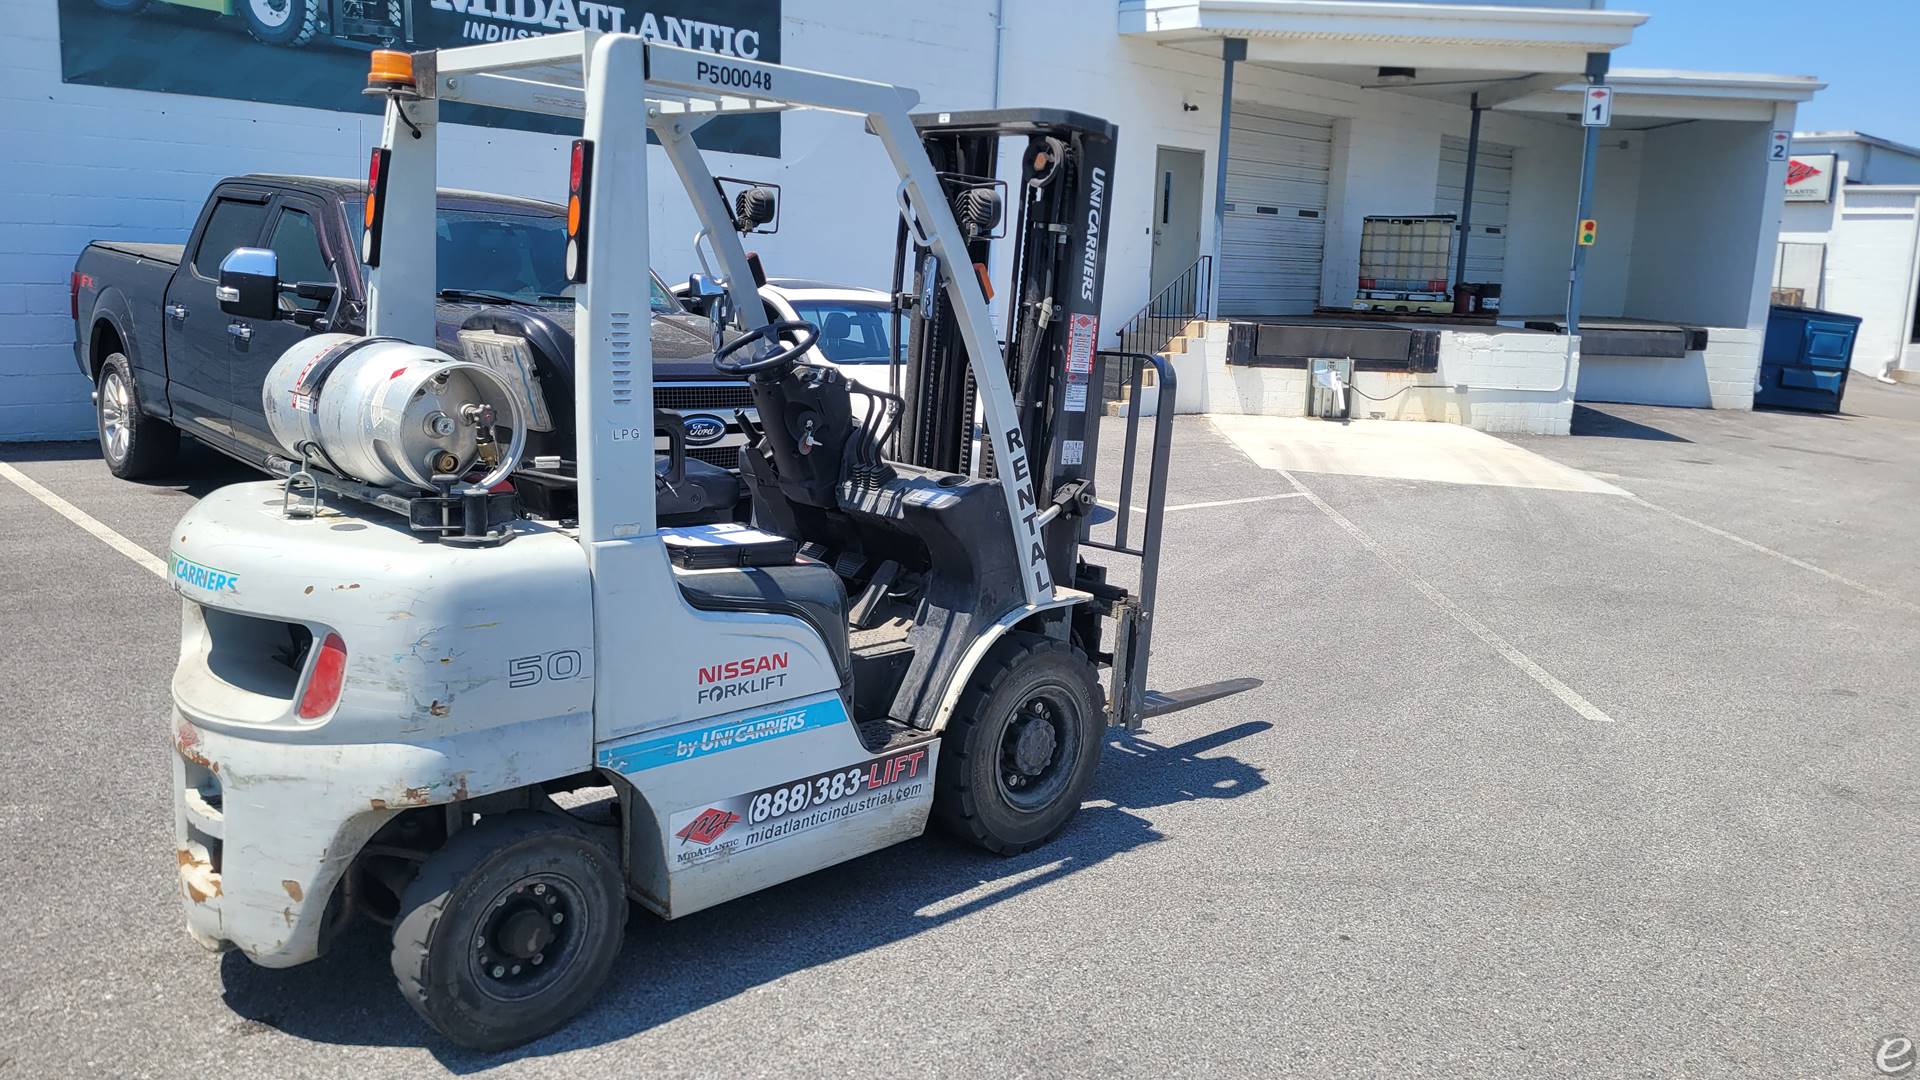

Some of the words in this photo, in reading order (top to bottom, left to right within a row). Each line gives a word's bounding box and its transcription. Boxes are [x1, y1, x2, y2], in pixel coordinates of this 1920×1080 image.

[463, 21, 551, 43] INDUS
[697, 61, 772, 91] P500048
[1591, 104, 1602, 121] 1
[1773, 145, 1784, 158] 2
[1081, 167, 1106, 303] UNICARRIERS
[613, 428, 640, 440] LPG
[690, 423, 715, 436] Ford
[1006, 427, 1050, 593] RENTAL
[509, 650, 582, 689] 50
[698, 652, 788, 685] NISSAN
[697, 673, 788, 704] FORKLIFT
[677, 740, 698, 758] by
[701, 713, 806, 751] UNICARRIERS
